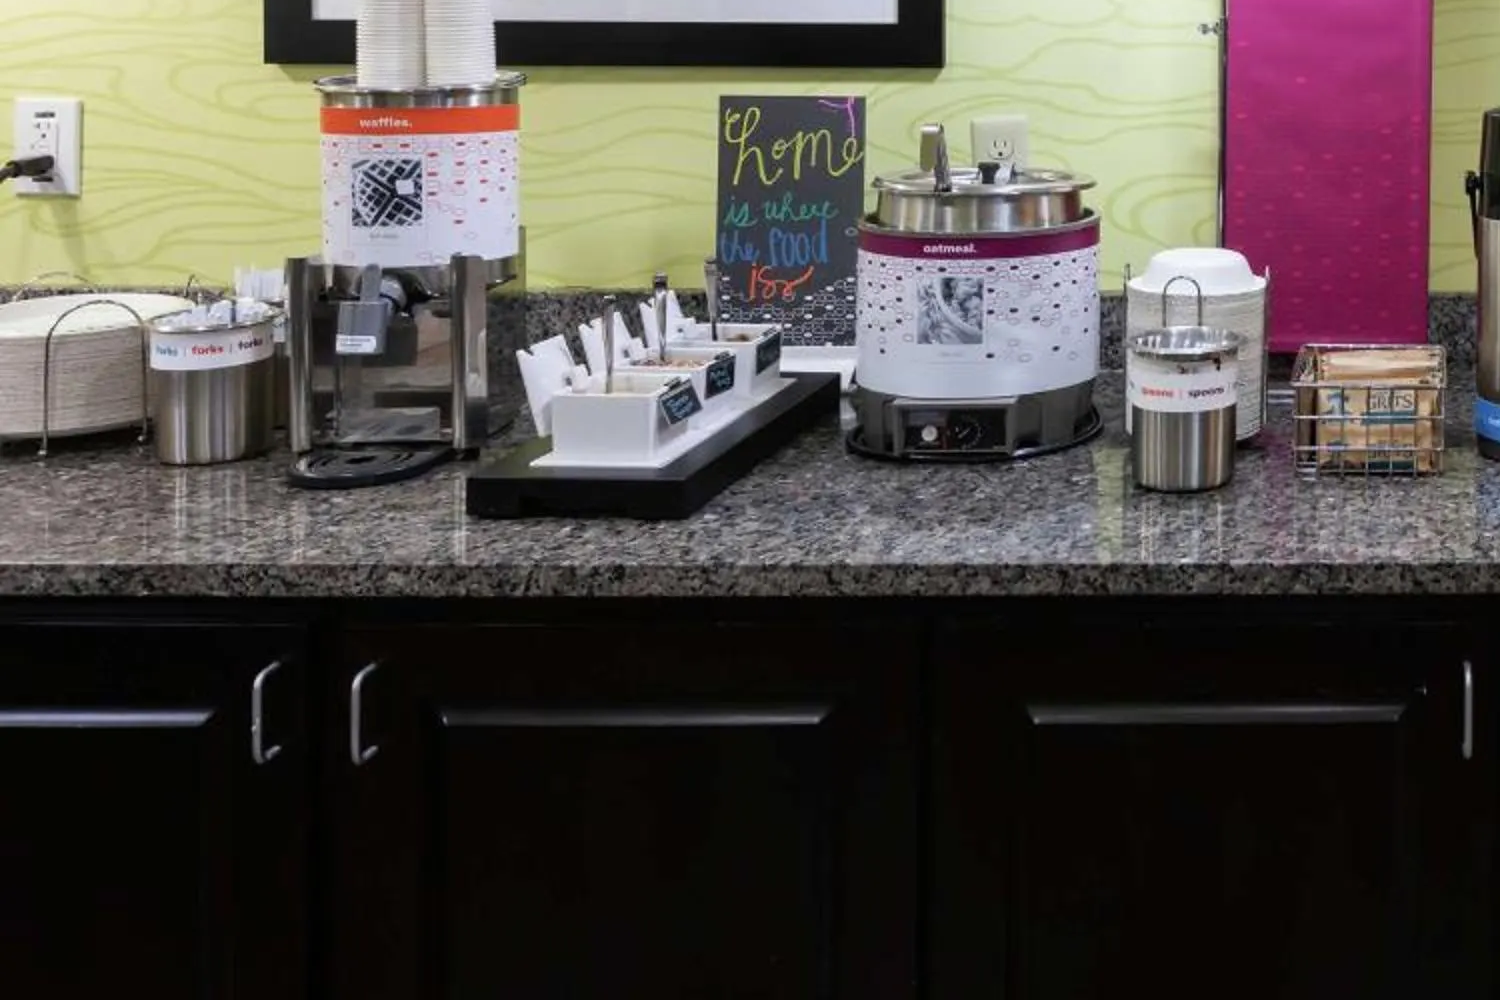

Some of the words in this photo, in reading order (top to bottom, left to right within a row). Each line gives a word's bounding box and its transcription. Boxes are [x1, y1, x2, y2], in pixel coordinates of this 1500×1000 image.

[359, 117, 413, 128] waffles.
[923, 242, 977, 253] oatmeal.
[191, 345, 224, 355] forks
[1188, 387, 1225, 399] spoons
